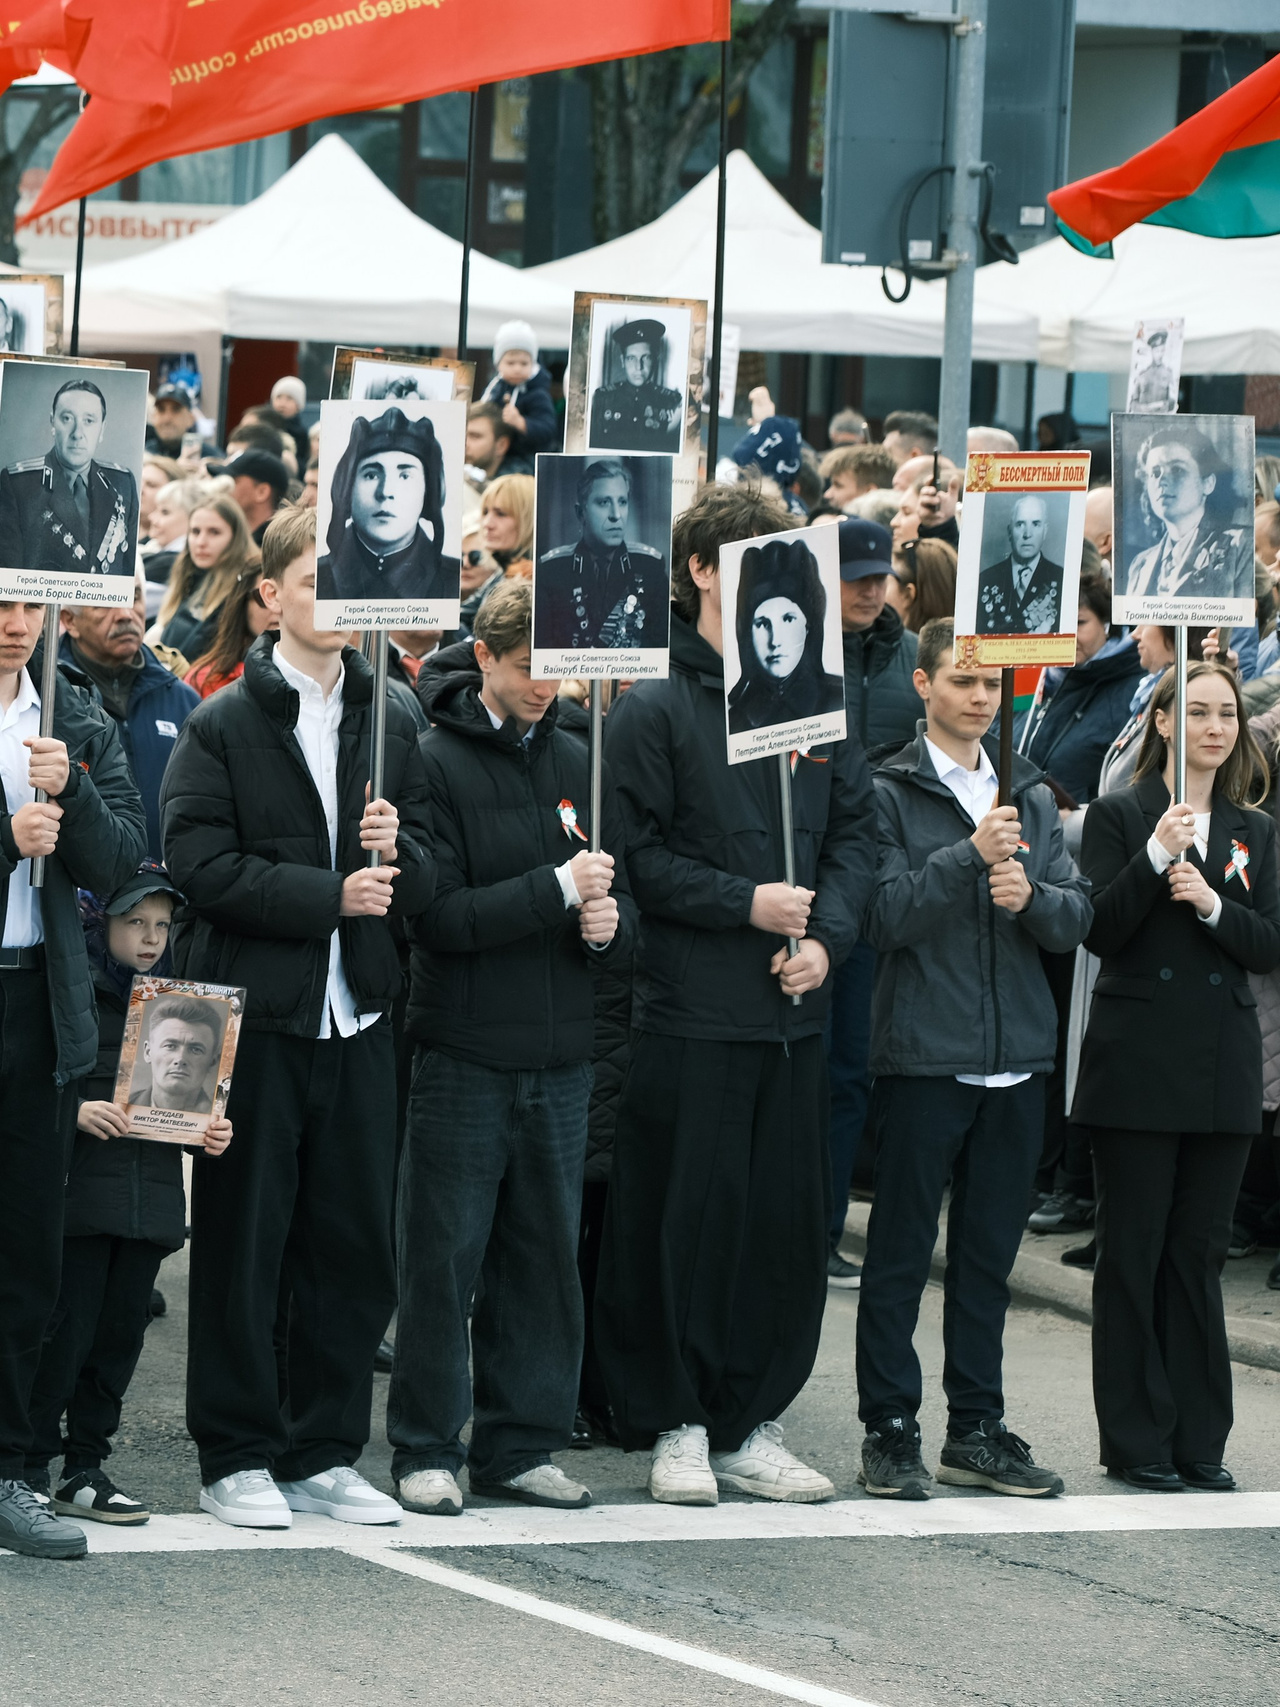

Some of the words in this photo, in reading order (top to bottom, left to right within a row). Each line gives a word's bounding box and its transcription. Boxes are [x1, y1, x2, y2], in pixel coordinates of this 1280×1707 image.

[1000, 462, 1061, 482] БЕССМЕРТНЫЙ
[1062, 466, 1086, 482] ПОЛК
[16, 575, 38, 585] Герой
[39, 577, 79, 587] Советского
[80, 579, 104, 588] Союза
[45, 588, 73, 600] Борис
[75, 590, 128, 603] Васильевич
[344, 605, 365, 614] Герой
[366, 605, 406, 613] Советского
[406, 605, 429, 613] Союза
[1142, 602, 1163, 610] Герой
[1164, 602, 1202, 610] Советского
[334, 616, 373, 627] Данилов
[374, 615, 410, 625] Алексей
[412, 615, 439, 625] Ильич
[1125, 611, 1150, 620] Троян
[1152, 611, 1189, 621] Надежда
[1191, 612, 1244, 622] Викторовна
[561, 654, 580, 663] Герой
[581, 654, 619, 662] Советского
[620, 654, 641, 662] Союза
[543, 664, 578, 675] Вайнруб
[580, 664, 604, 674] Евсей
[606, 664, 658, 675] Григорьевич
[752, 733, 769, 743] Герой
[770, 727, 802, 738] Советского
[803, 722, 821, 731] Союза
[735, 745, 766, 758] Петряев
[767, 736, 805, 750] Александр
[806, 728, 841, 742] Акимович
[150, 1109, 185, 1119] СЕРЕДАЕВ
[133, 1115, 160, 1123] ВИКТОР
[160, 1118, 199, 1128] МАТВЕЕВИЧ
